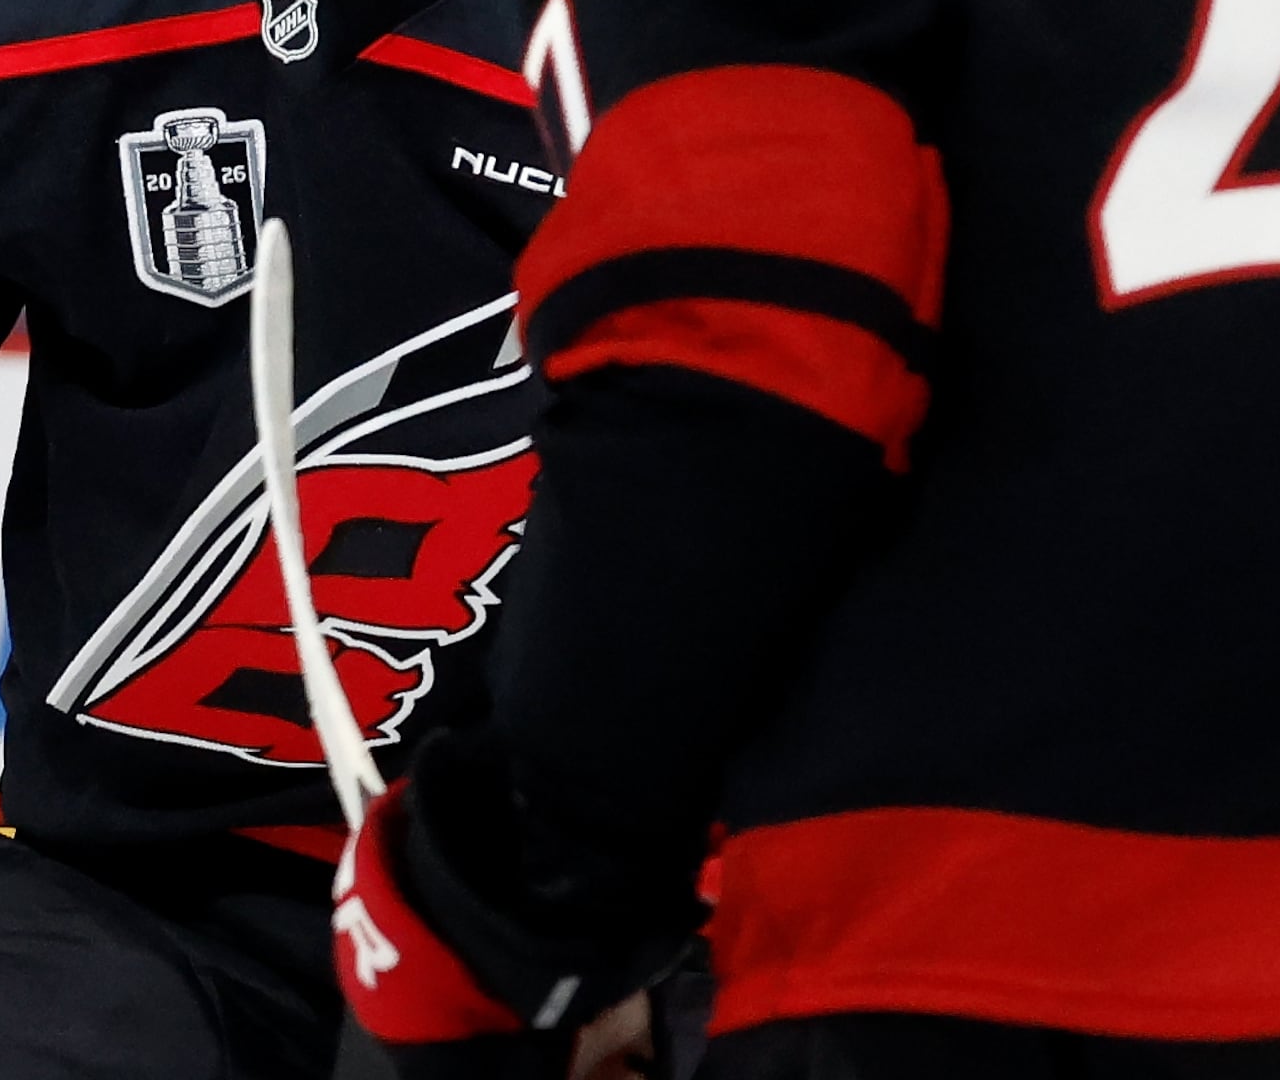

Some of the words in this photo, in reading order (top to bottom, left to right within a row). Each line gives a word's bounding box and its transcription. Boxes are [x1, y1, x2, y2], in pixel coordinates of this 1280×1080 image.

[273, 5, 307, 43] NHL
[146, 173, 172, 192] 20
[220, 165, 246, 185] 26
